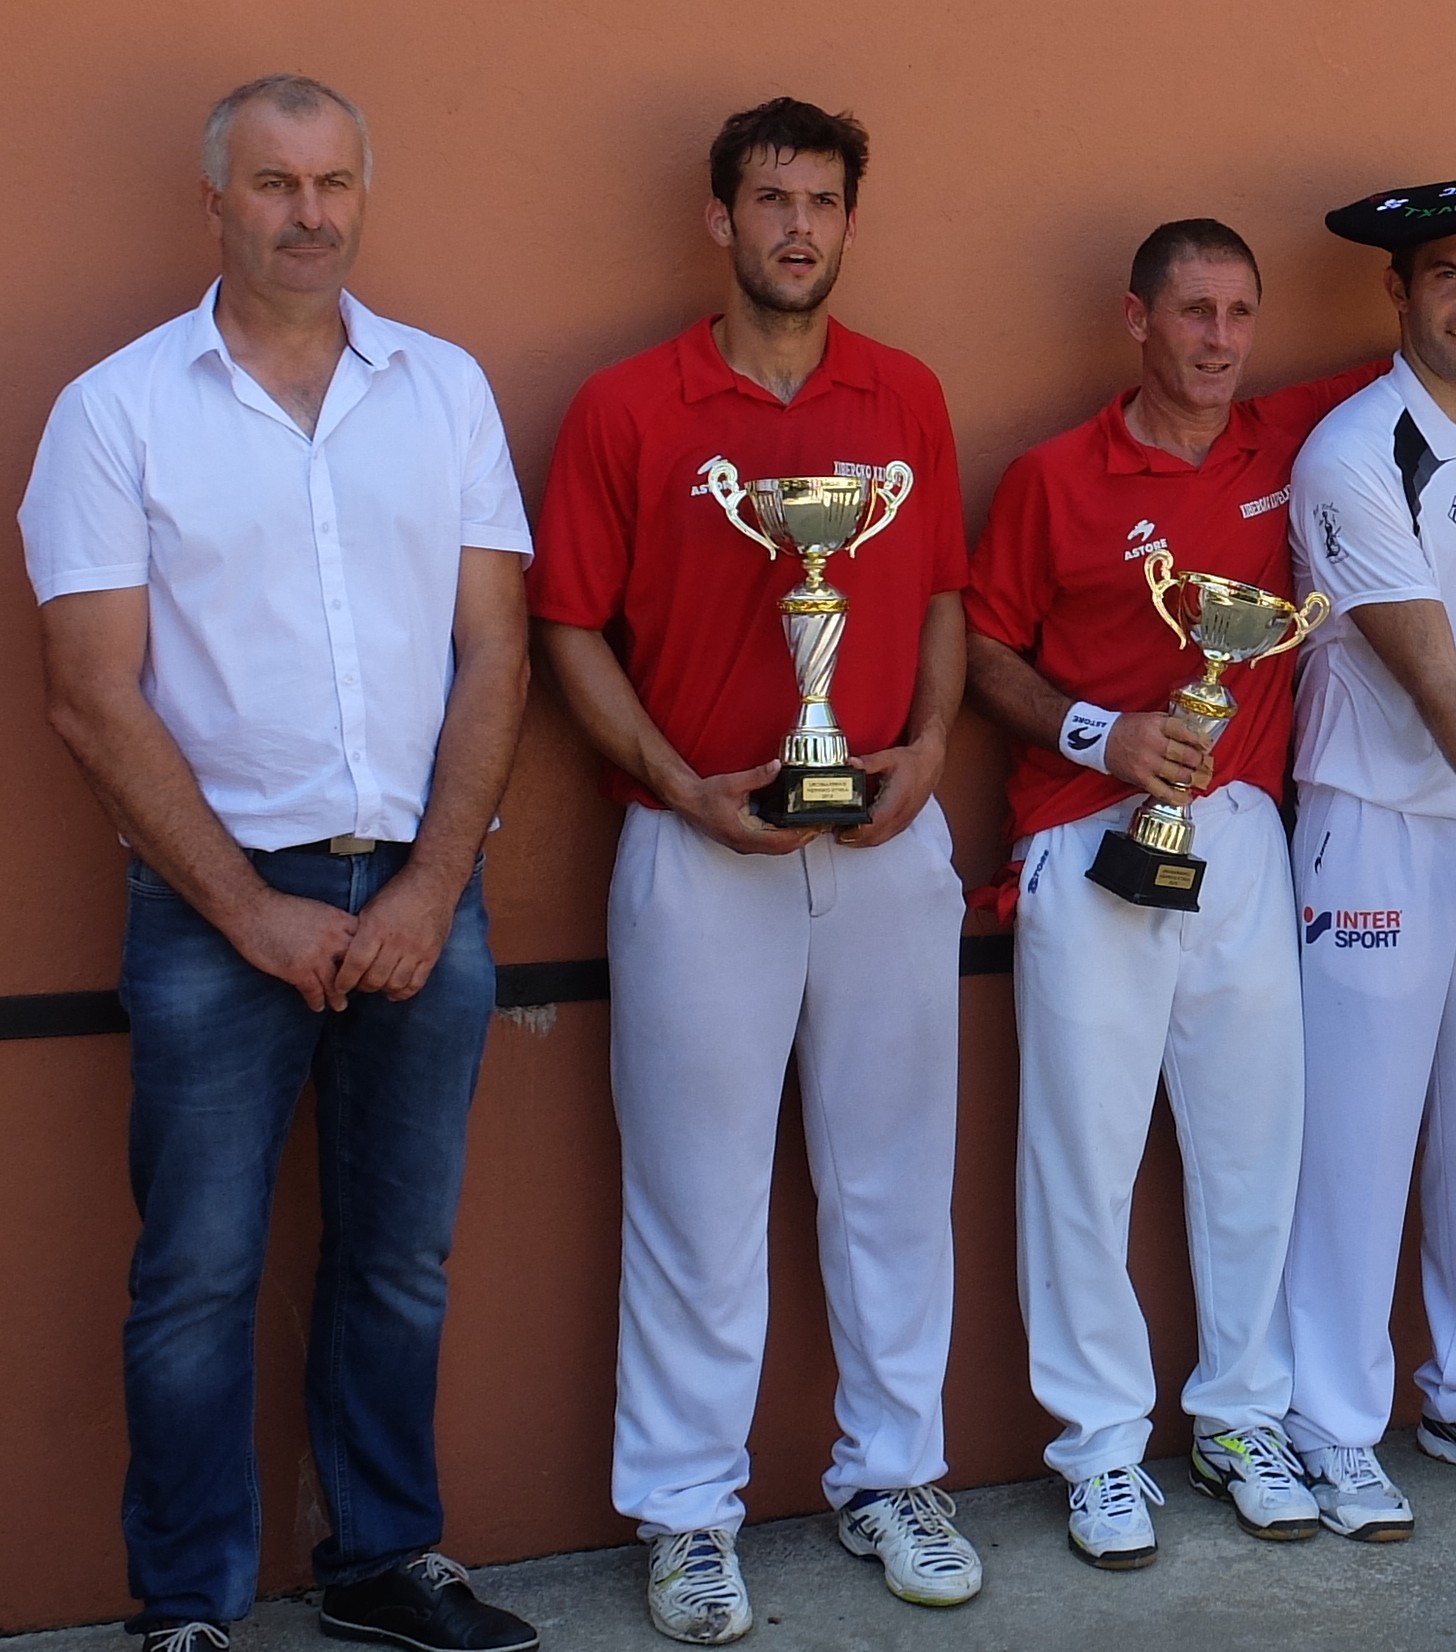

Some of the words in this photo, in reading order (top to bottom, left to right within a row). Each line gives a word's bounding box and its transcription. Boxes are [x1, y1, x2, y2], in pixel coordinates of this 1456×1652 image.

[1124, 538, 1168, 561] ASTORE
[1072, 715, 1108, 729] ASTORE
[1336, 910, 1401, 929] INTER
[1335, 930, 1401, 948] SPORT
